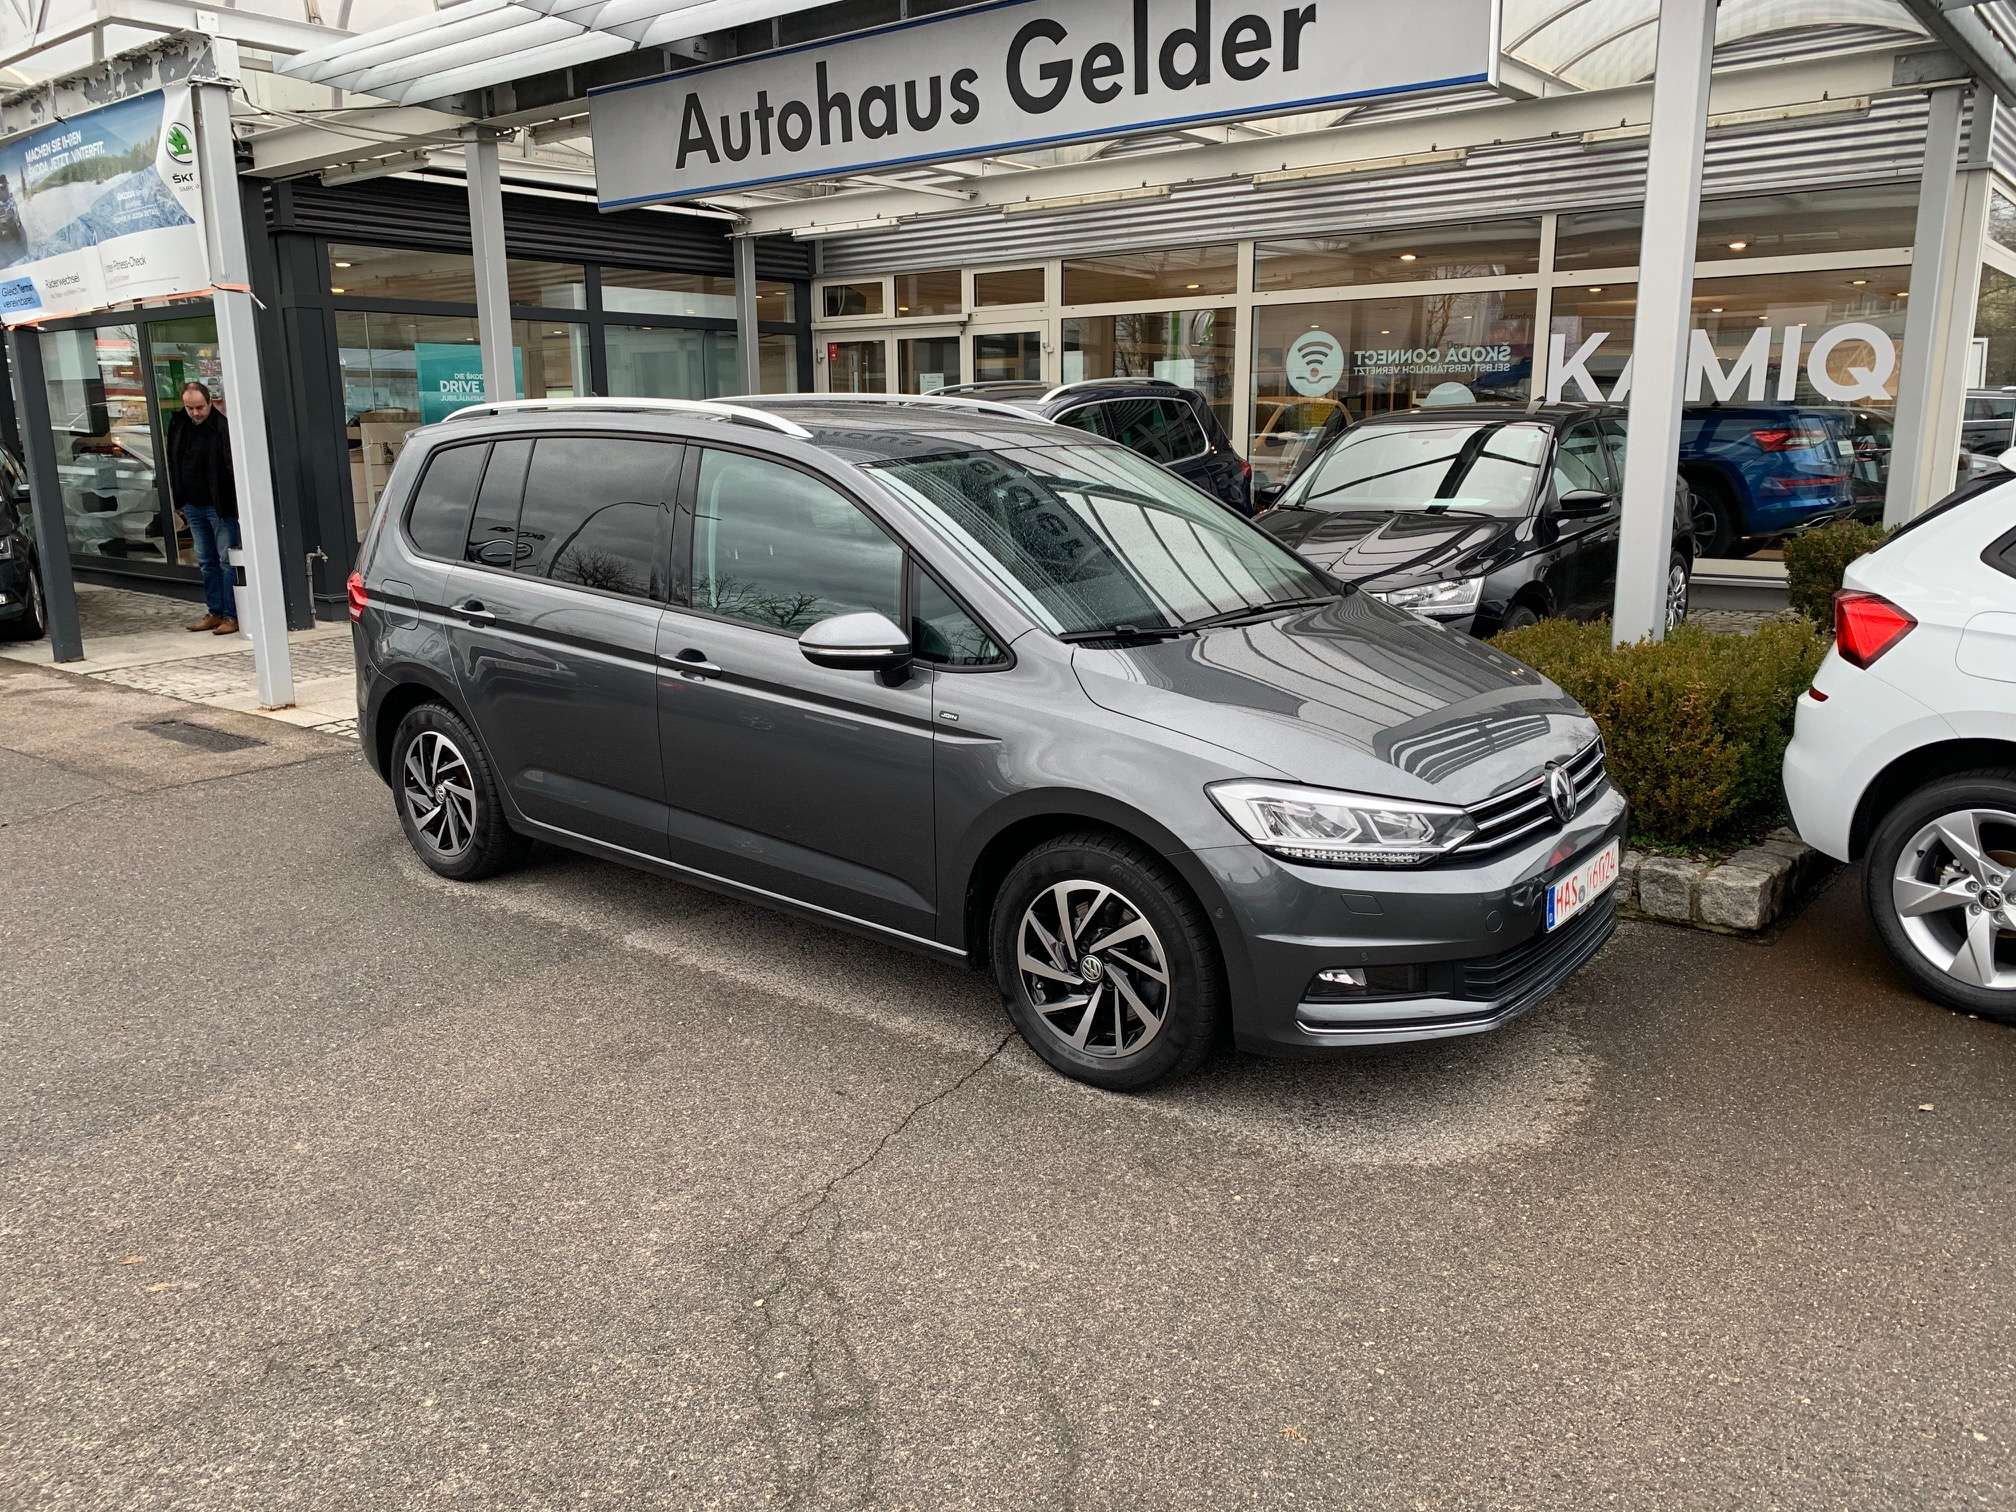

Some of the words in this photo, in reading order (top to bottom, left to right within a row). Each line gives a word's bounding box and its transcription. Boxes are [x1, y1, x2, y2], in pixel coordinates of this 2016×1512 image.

[675, 61, 979, 169] Autohaus
[1006, 0, 1316, 114] Gelder
[25, 142, 51, 163] MACHEN
[440, 380, 480, 393] DRIVE
[1556, 875, 1578, 918] HAS
